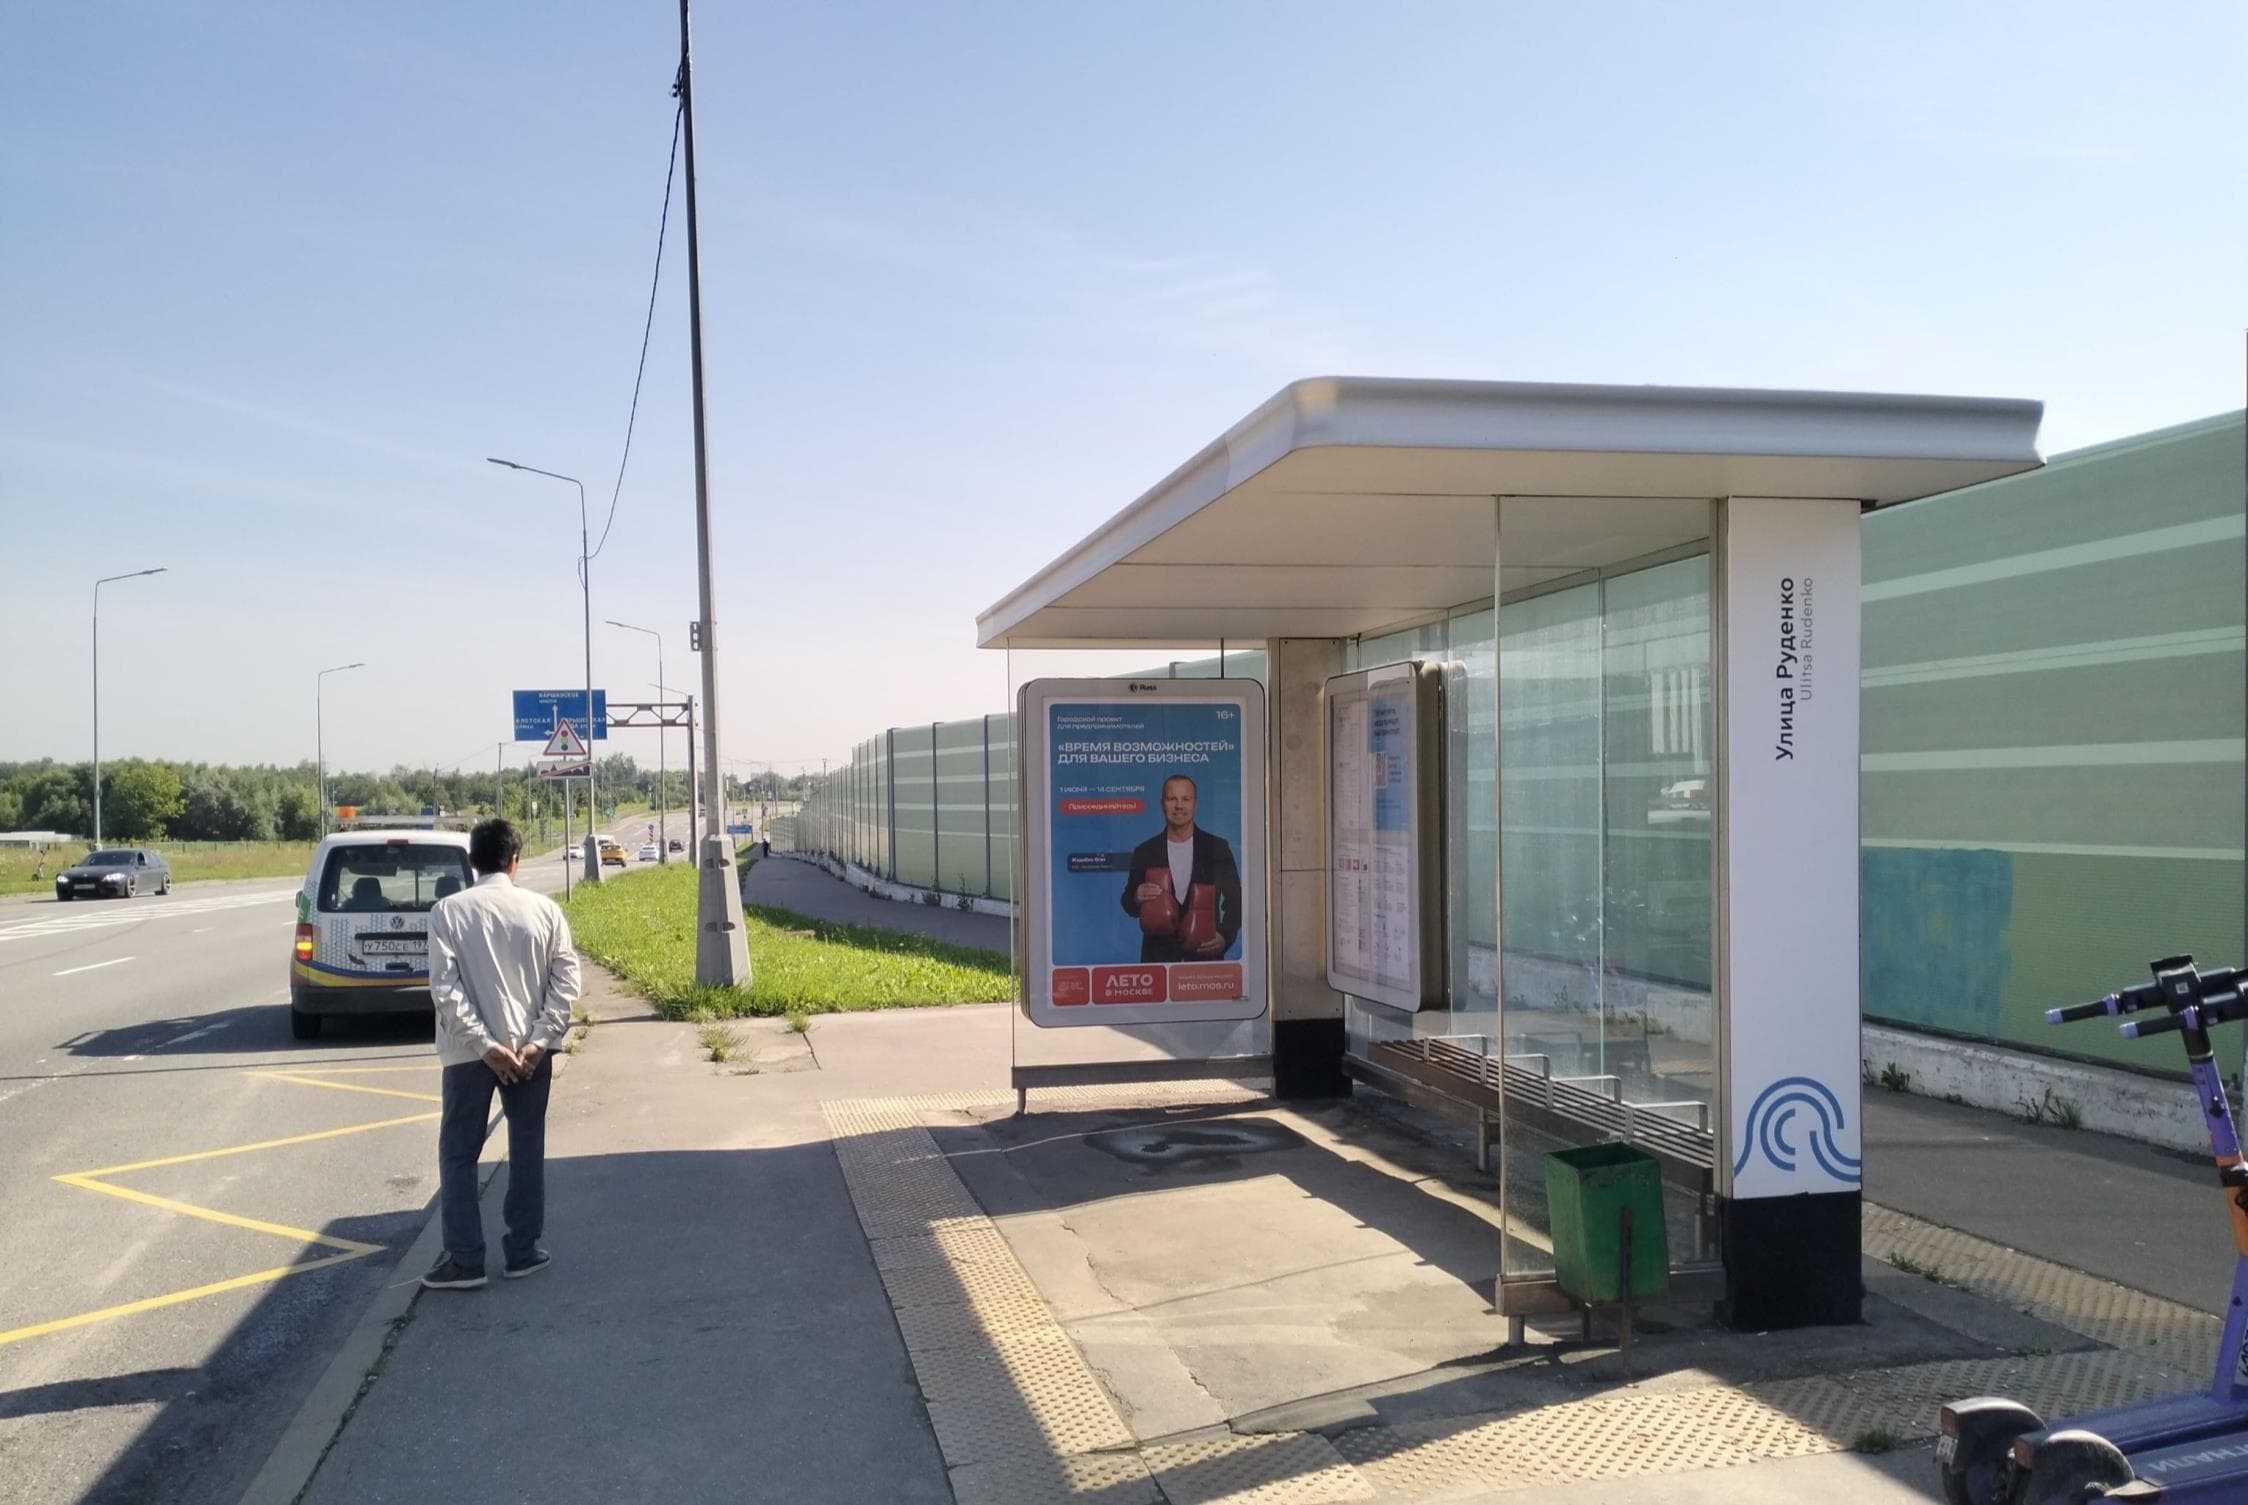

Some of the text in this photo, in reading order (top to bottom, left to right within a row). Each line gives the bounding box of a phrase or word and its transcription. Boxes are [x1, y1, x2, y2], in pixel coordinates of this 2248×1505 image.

[1800, 577, 1813, 701] Ulitsa Rudenko
[1776, 577, 1797, 760] Улица Руденко
[1216, 711, 1235, 720] 16+
[1058, 739, 1235, 752] «ВРЕМЯ ВОЗМОЖНОСТЕЙ»
[1057, 753, 1209, 764] ДЛЯ ВАШЕГО БИЗНЕСА
[1106, 973, 1154, 988] ЛЕТО
[1178, 980, 1235, 991] leto.mos.ru
[1115, 988, 1153, 997] МОСКВЕ
